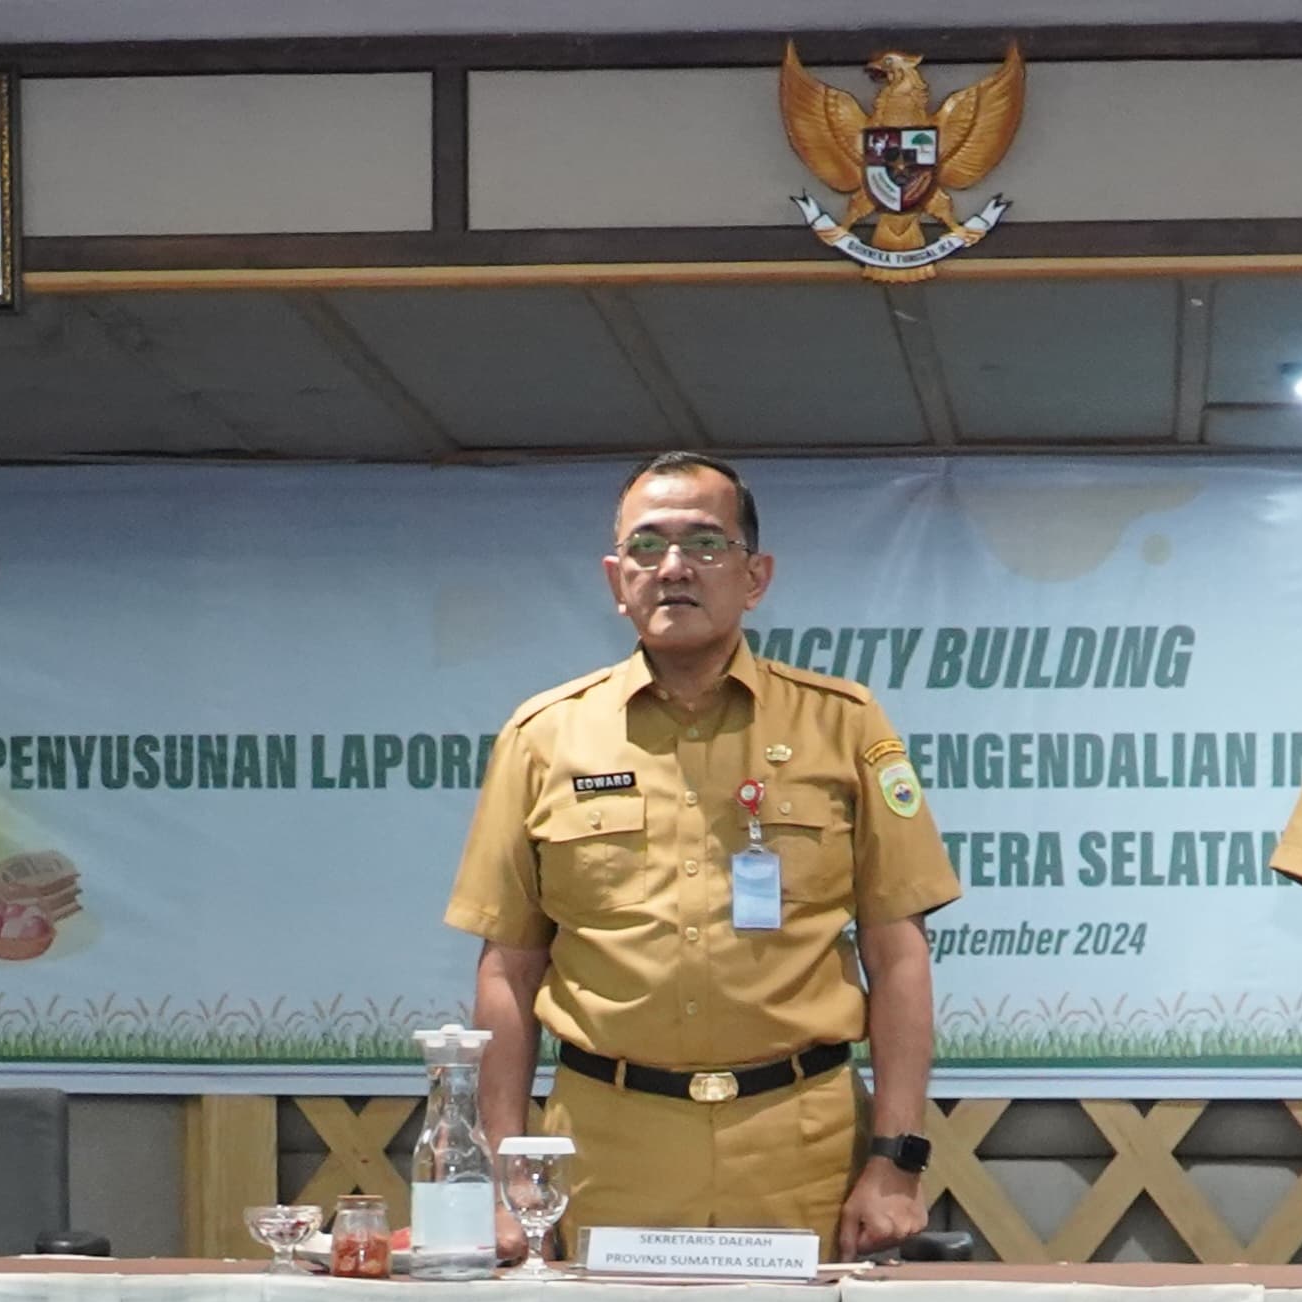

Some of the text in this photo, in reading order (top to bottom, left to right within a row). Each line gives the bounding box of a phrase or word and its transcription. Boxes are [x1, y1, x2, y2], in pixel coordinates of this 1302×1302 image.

[925, 625, 1196, 689] BUILDING
[576, 774, 633, 790] EDWARD
[909, 732, 1256, 789] ENGENDALIAN
[941, 831, 1064, 888] TERA
[927, 921, 1148, 964] eptember 2024
[605, 1253, 804, 1269] PROVINSI SUMATERA SELATAN
[640, 1234, 773, 1247] SEKRETARIS DAERAH
